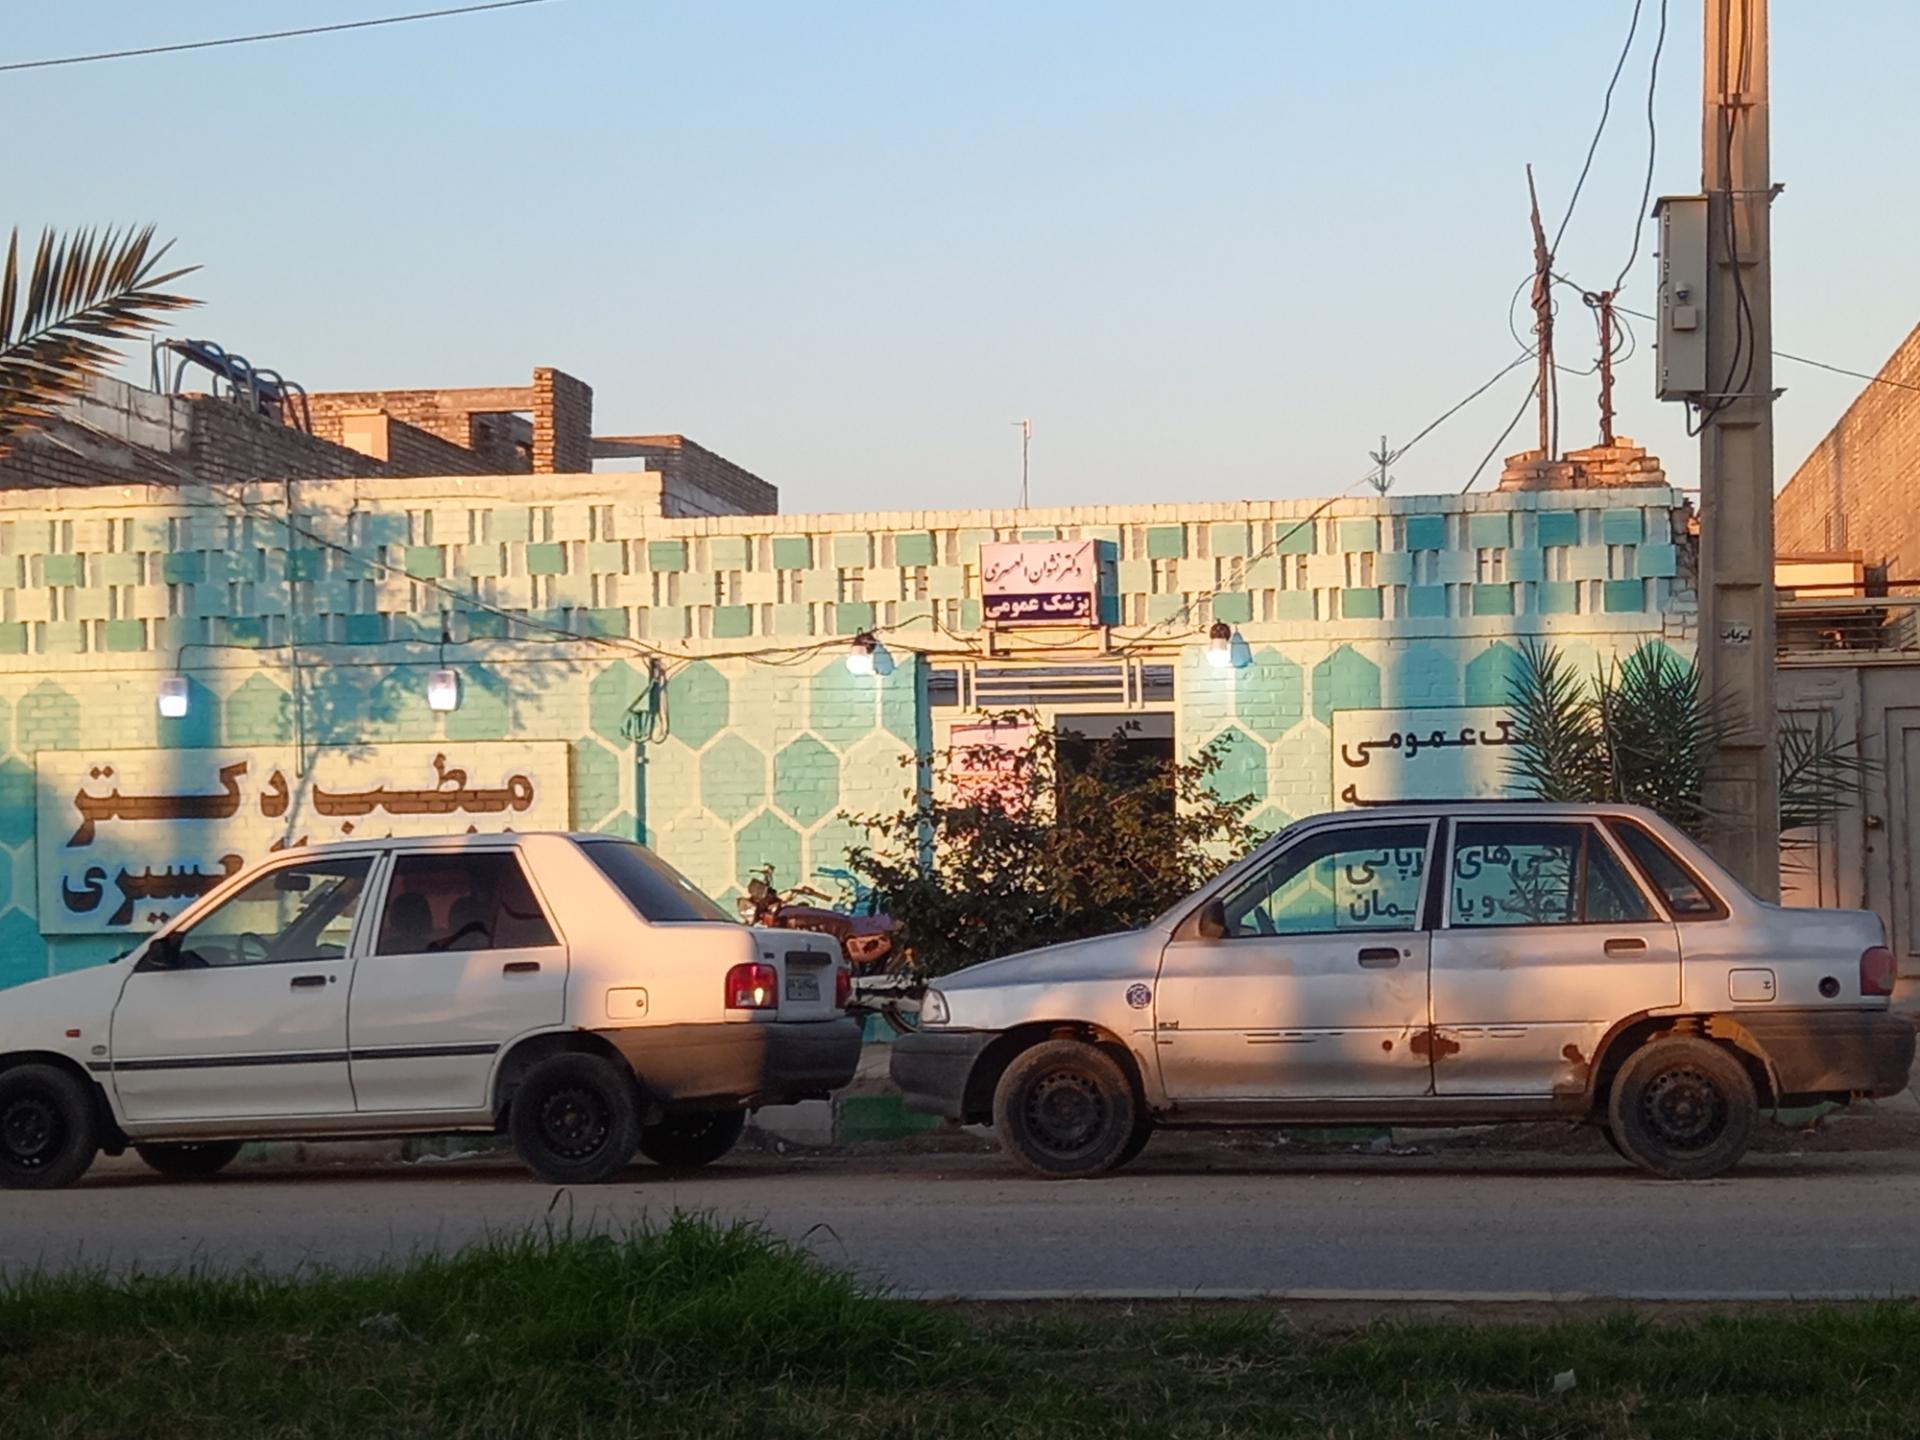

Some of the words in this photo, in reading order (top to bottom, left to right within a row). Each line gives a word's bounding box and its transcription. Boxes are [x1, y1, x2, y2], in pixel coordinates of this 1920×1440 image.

[1056, 541, 1091, 582] دکتر
[985, 598, 1039, 617] عمومی
[1043, 594, 1090, 616] پزشک
[1342, 727, 1476, 768] عمومی
[66, 761, 290, 848] دکتر
[312, 752, 536, 834] مطب
